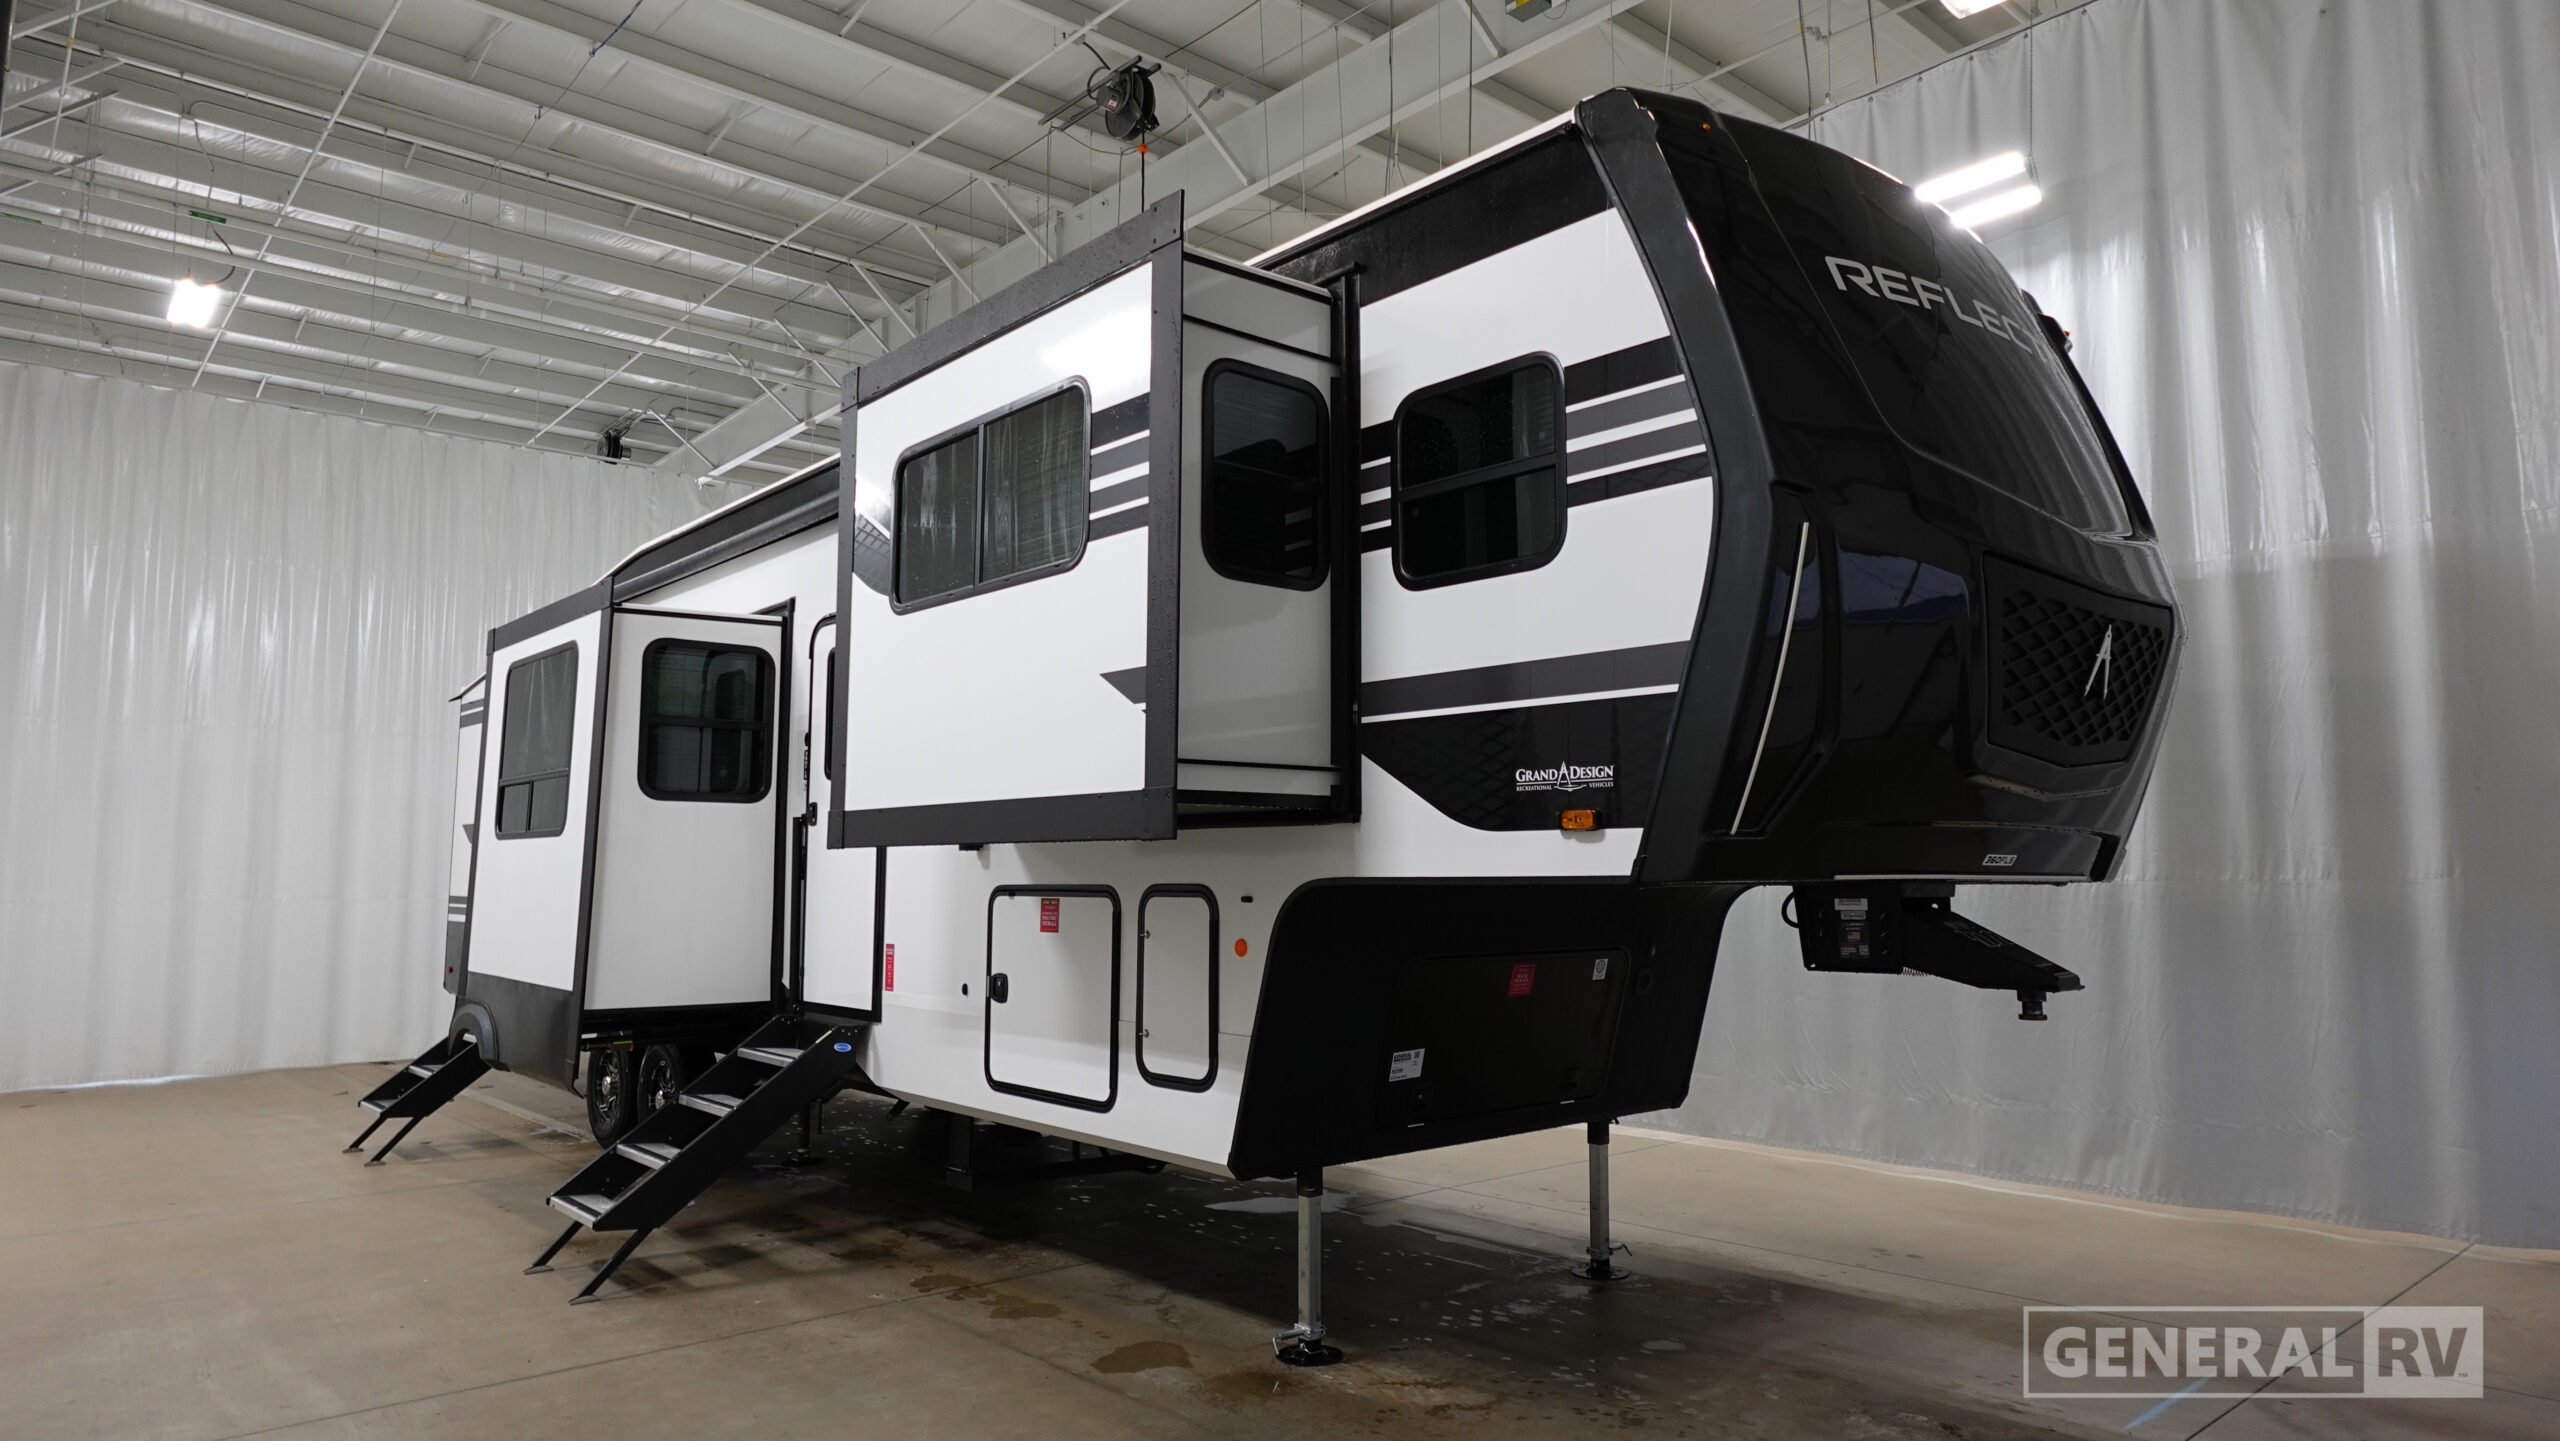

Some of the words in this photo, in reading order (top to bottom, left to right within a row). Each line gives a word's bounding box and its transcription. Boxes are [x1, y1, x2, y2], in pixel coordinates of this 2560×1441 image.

[1516, 768, 1558, 782] GRAND
[1570, 765, 1613, 779] DESIGN
[1516, 784, 1552, 792] RECREATIONAL
